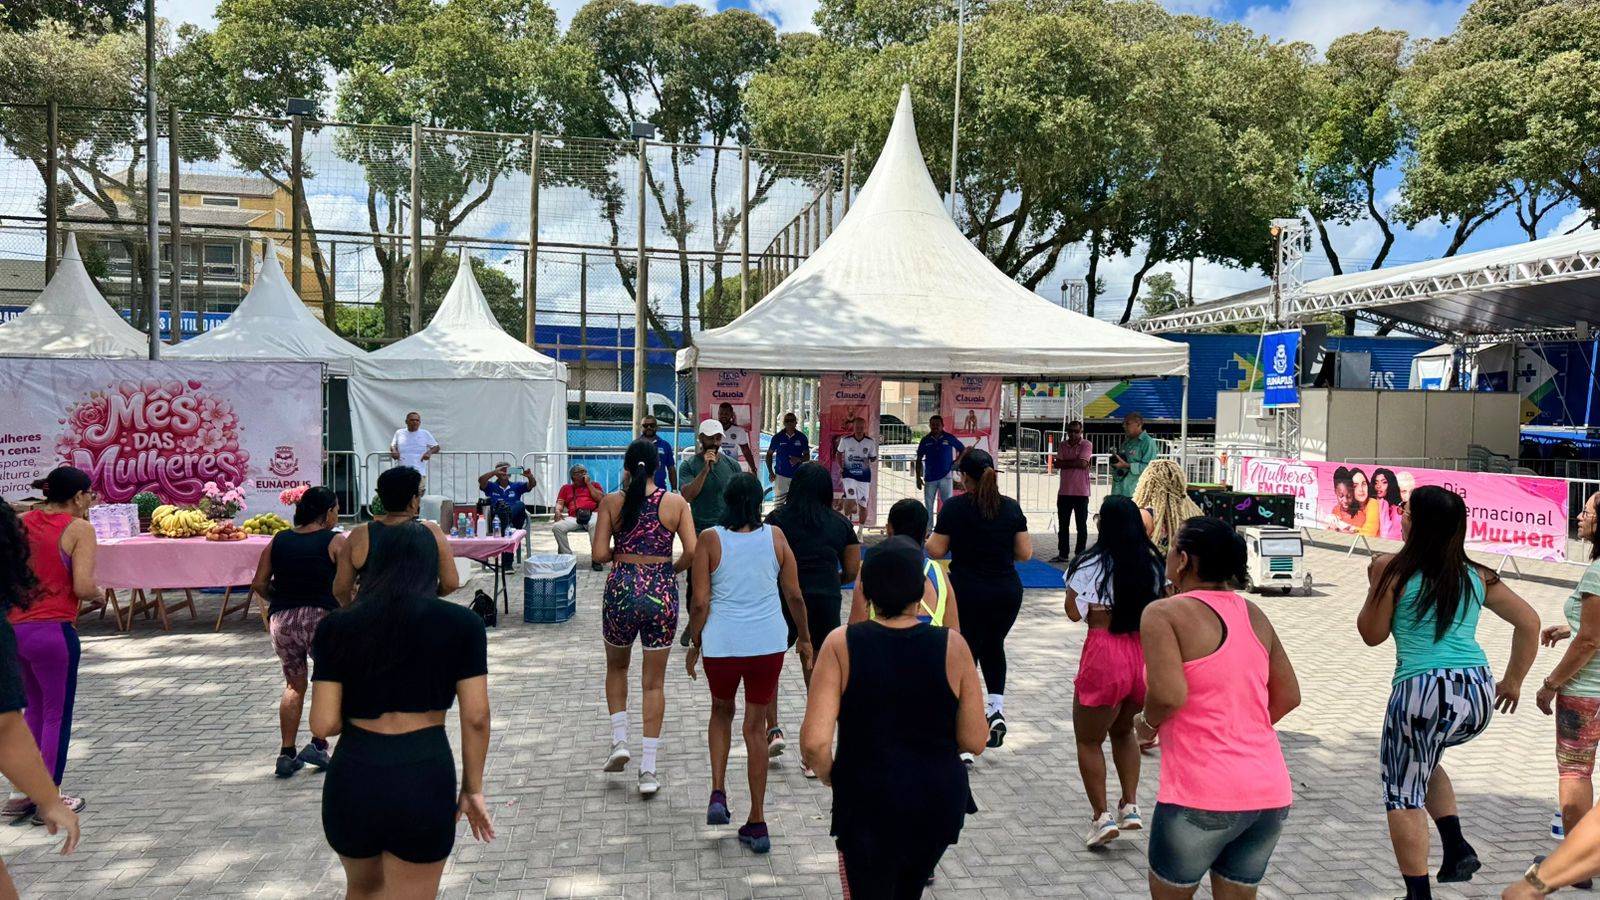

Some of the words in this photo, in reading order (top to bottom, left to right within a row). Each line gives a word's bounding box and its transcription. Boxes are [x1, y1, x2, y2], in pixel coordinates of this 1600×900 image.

[0, 434, 42, 444] ulheres
[133, 432, 175, 450] DAS
[8, 446, 41, 455] cena:
[0, 459, 37, 470] sporte,
[0, 471, 30, 480] ltura
[73, 445, 240, 502] Mulheres
[1250, 461, 1315, 484] Mulheres
[1258, 482, 1273, 494] EM
[1275, 484, 1306, 498] CENA
